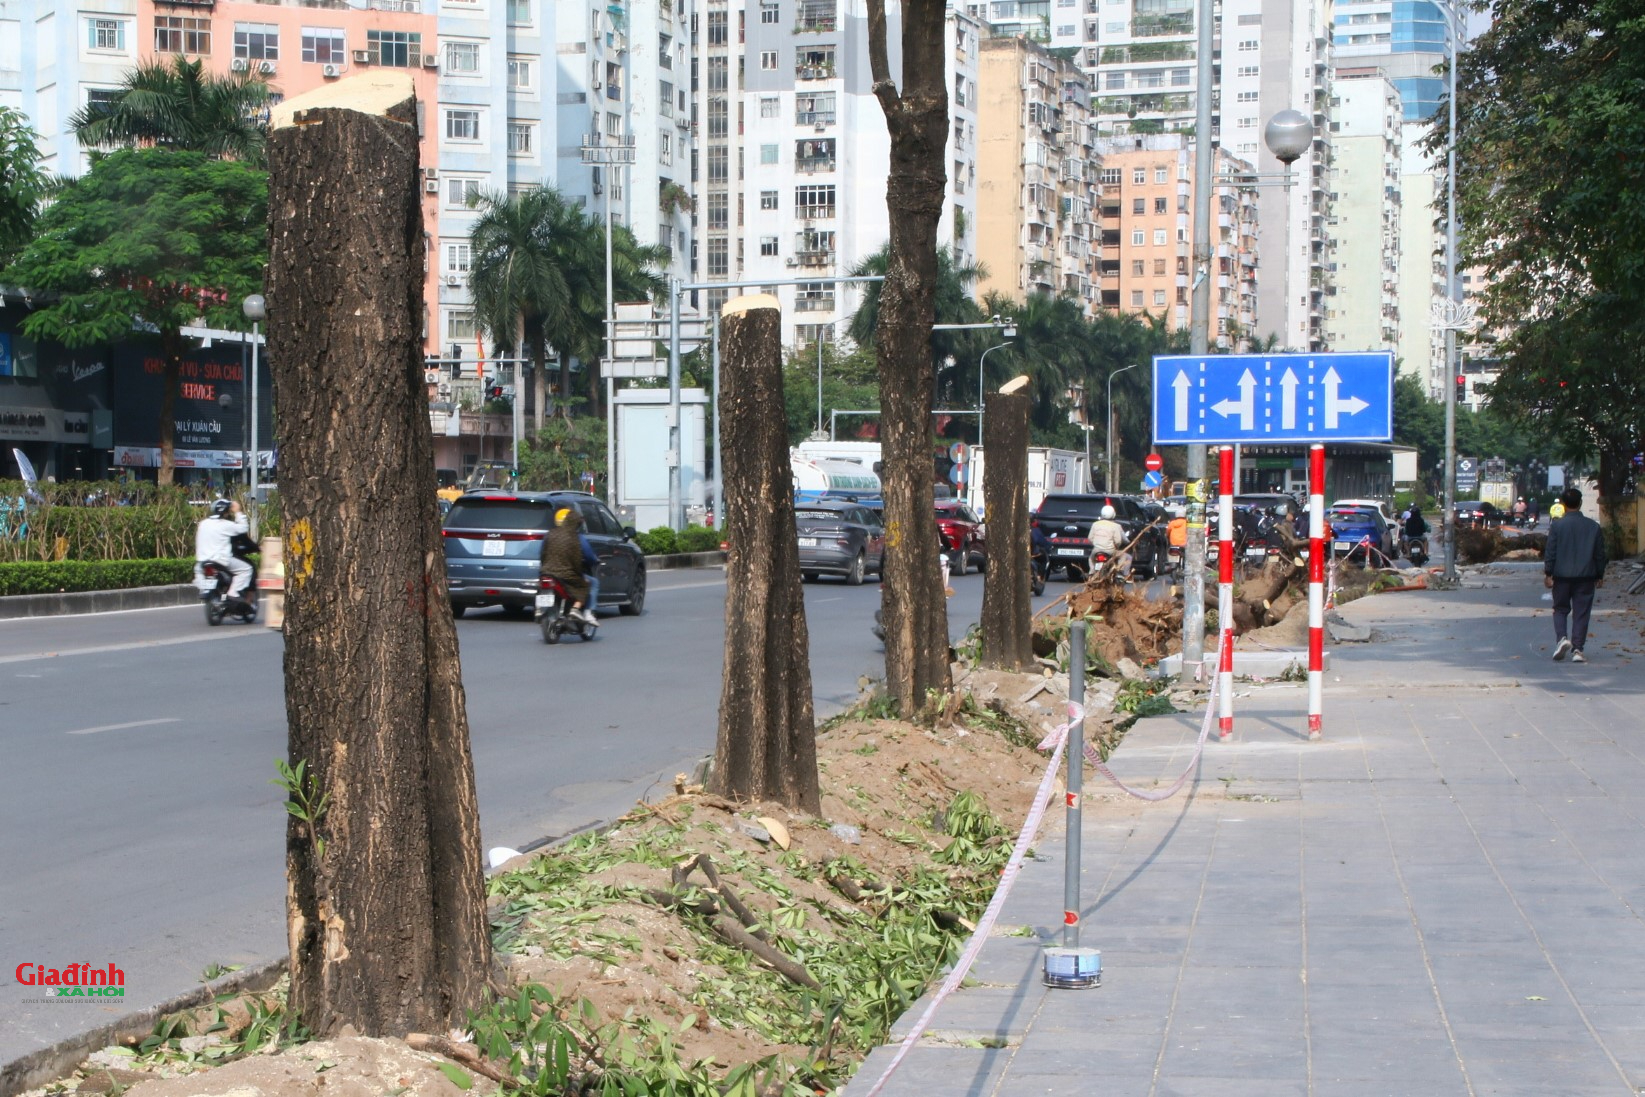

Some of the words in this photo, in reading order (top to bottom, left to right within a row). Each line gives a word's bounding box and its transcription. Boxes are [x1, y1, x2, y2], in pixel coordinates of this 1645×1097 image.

[72, 360, 104, 381] Vespa
[180, 382, 216, 401] SERVICE
[183, 419, 191, 432] LÝ
[192, 420, 208, 433] XUÂN
[209, 419, 221, 433] CẦU
